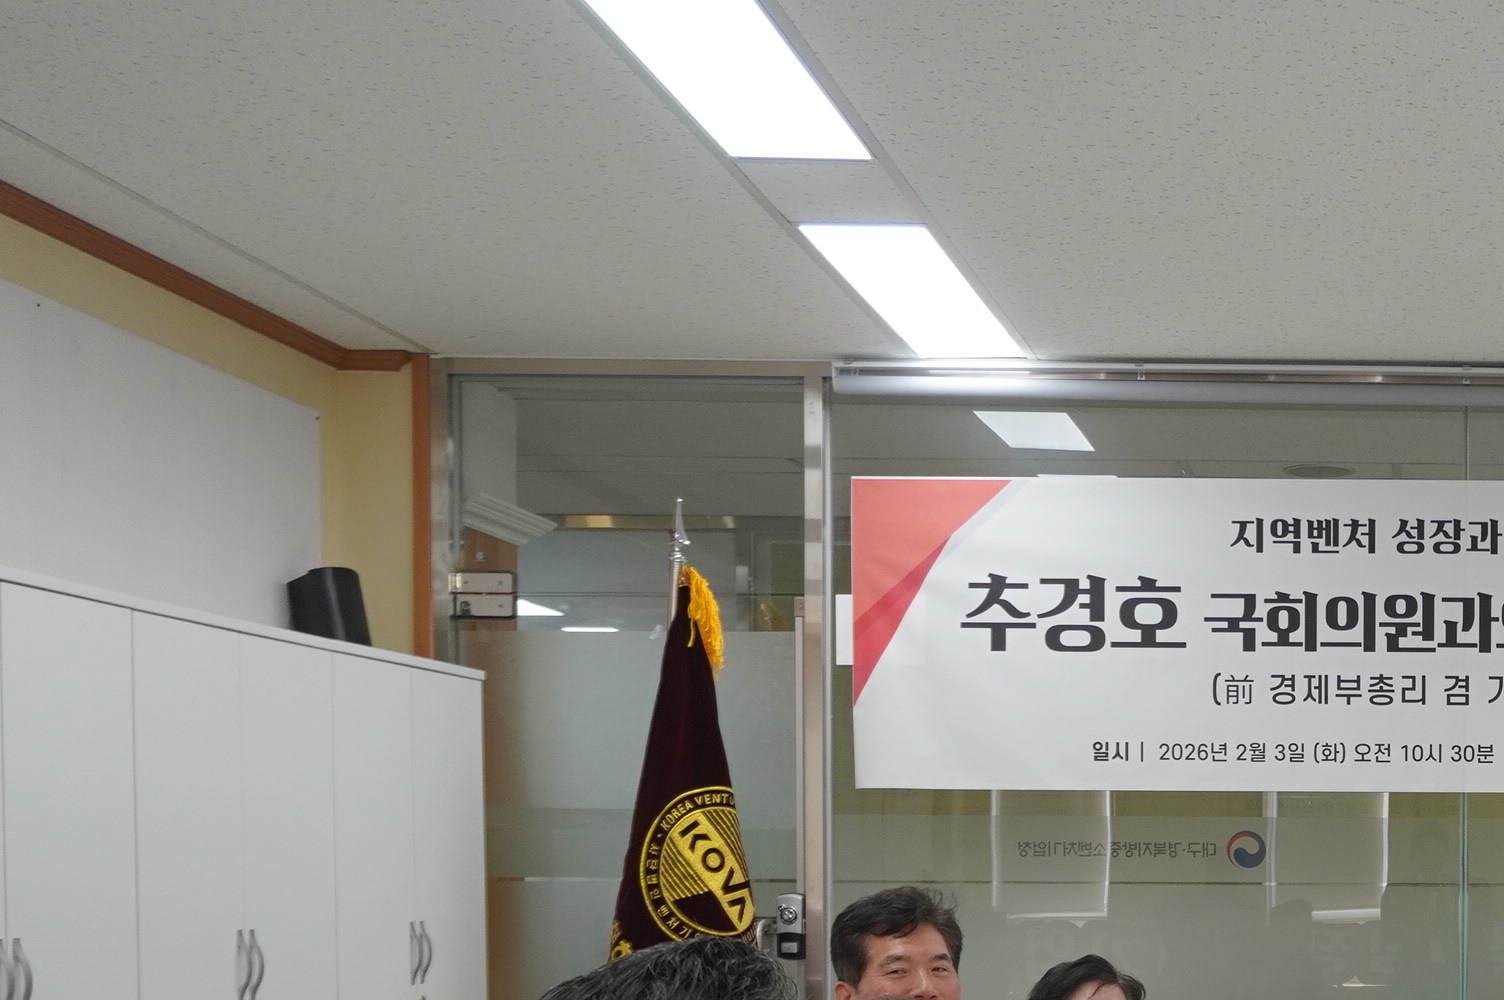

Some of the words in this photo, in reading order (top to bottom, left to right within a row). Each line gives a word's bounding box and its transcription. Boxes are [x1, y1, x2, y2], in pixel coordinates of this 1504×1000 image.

[1230, 517, 1377, 555] 지역벤처
[1391, 517, 1503, 555] 성장과
[960, 572, 1187, 653] 추경호
[1212, 672, 1255, 706] (前
[1269, 673, 1427, 706] 경제부총리
[1443, 675, 1470, 706] 겸
[1092, 741, 1129, 762] 일시
[1159, 742, 1228, 763] 2026년
[1235, 742, 1266, 763] 2월
[1274, 742, 1305, 763] 3일
[1313, 741, 1346, 764] (화)
[1353, 743, 1391, 763] 오전
[1400, 743, 1442, 764] 10시
[1450, 744, 1495, 764] 30분
[661, 801, 693, 830] KOREA
[647, 844, 661, 900] 사단법인
[680, 822, 750, 925] KOVA
